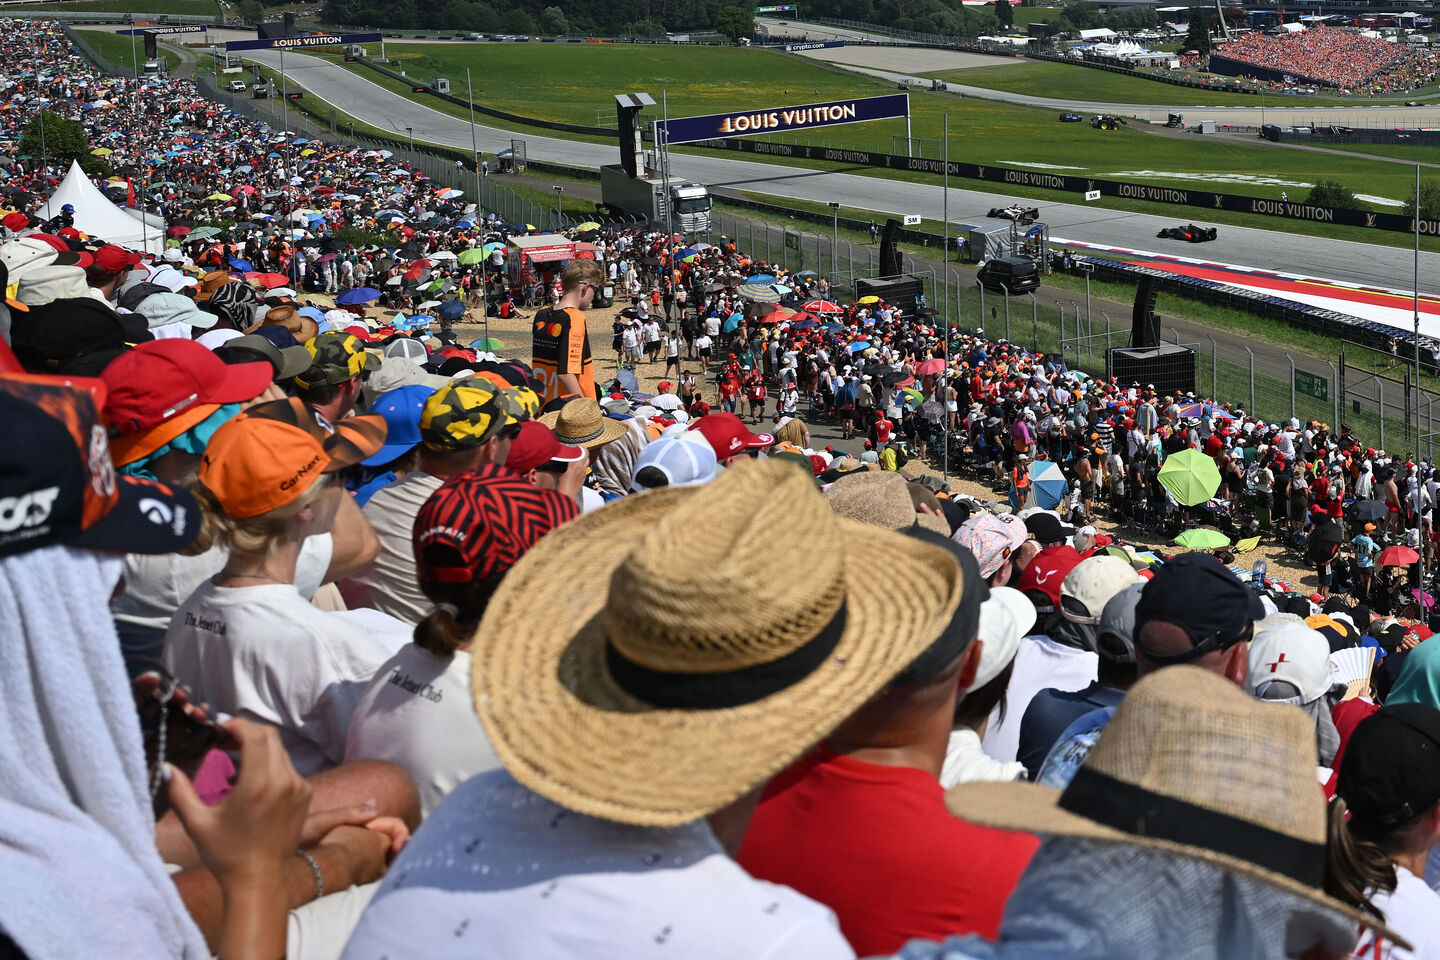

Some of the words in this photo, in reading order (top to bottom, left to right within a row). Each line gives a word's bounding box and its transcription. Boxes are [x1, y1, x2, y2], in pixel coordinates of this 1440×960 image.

[274, 38, 301, 47] LOUIS
[303, 36, 342, 45] VUITTON
[792, 43, 825, 52] crypto.com
[726, 111, 779, 133] LOUIS
[782, 103, 856, 126] VUITTON
[825, 151, 843, 160] LOUIS
[909, 159, 928, 170] LOUIS
[930, 162, 958, 173] VUITON
[1005, 171, 1029, 183] LOUIS
[1030, 174, 1065, 188] VUITTON
[1119, 184, 1146, 198] LOUIS
[1148, 187, 1187, 203] VUITTON
[1252, 200, 1284, 216] LOUIS
[1286, 203, 1333, 222] VUITTON
[185, 612, 198, 628] The
[389, 670, 402, 684] The
